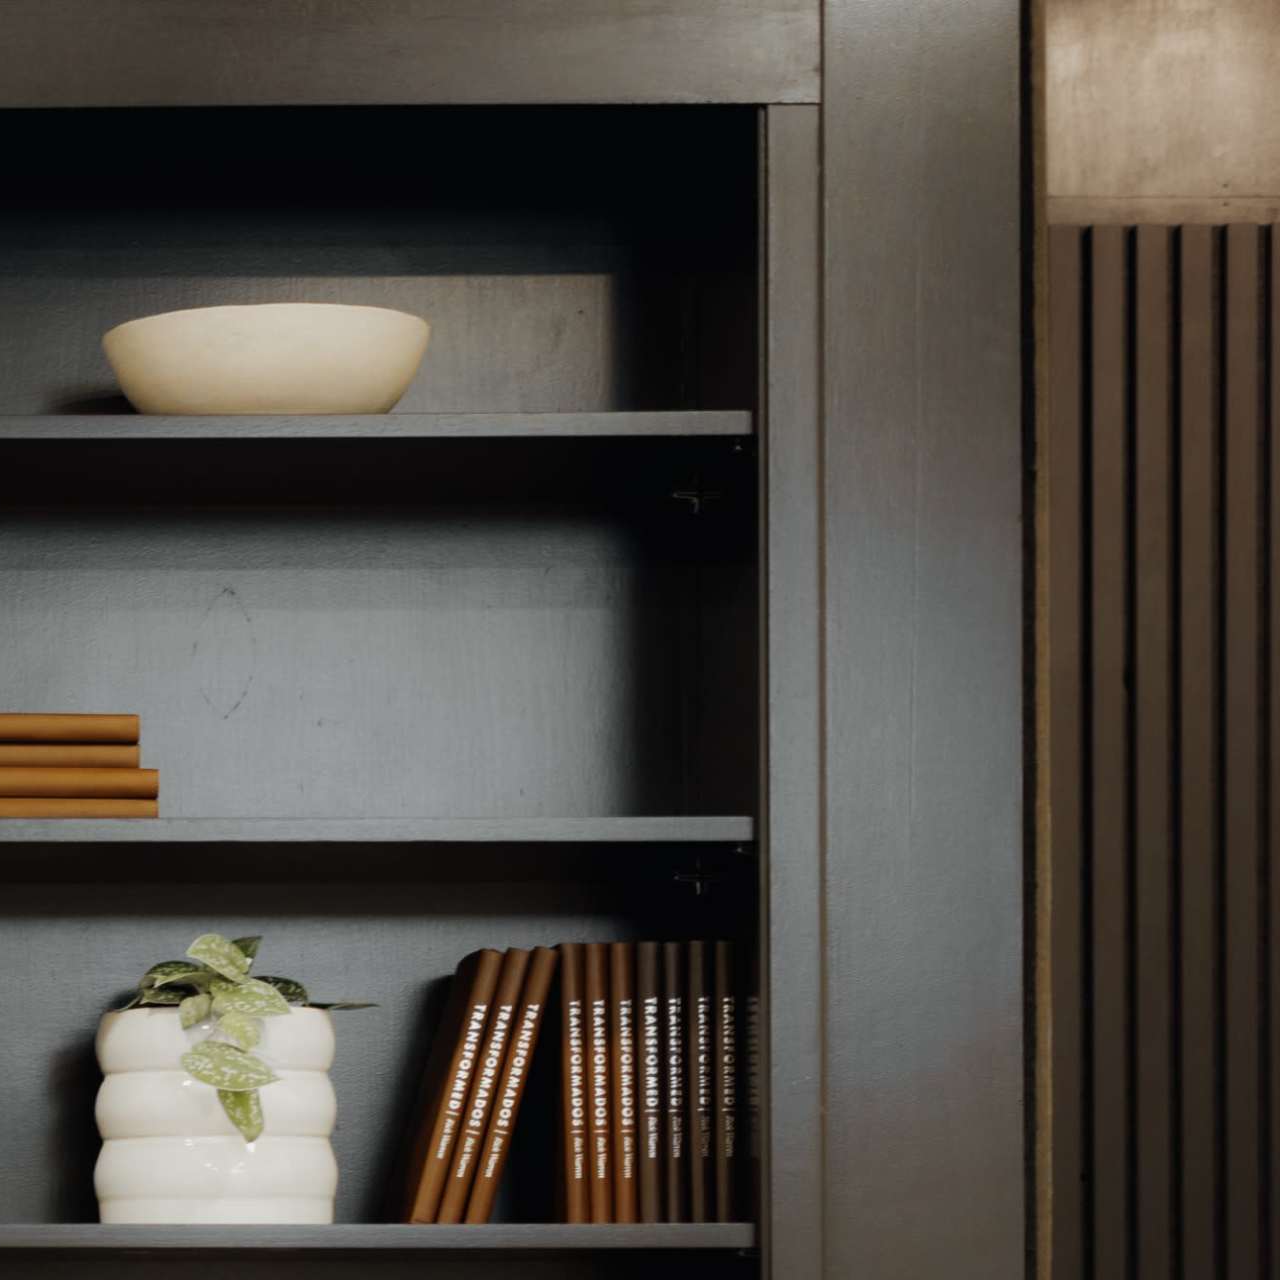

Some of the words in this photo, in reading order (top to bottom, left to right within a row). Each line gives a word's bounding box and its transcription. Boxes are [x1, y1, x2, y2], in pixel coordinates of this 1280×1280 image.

[449, 1004, 487, 1110] TRANSFORMED
[468, 1005, 513, 1127] TRANSFORMADOS
[496, 1004, 540, 1127] TRANSFORMADOS
[569, 1000, 584, 1127] TRANSFORMADOS
[593, 1000, 608, 1127] TRANSFORMADOS
[620, 1000, 634, 1127] TRANSFORMADOS
[644, 997, 659, 1107] TRANSFORMED
[668, 997, 683, 1107] TRANSFORMED
[722, 997, 735, 1106] TRANSFORMED
